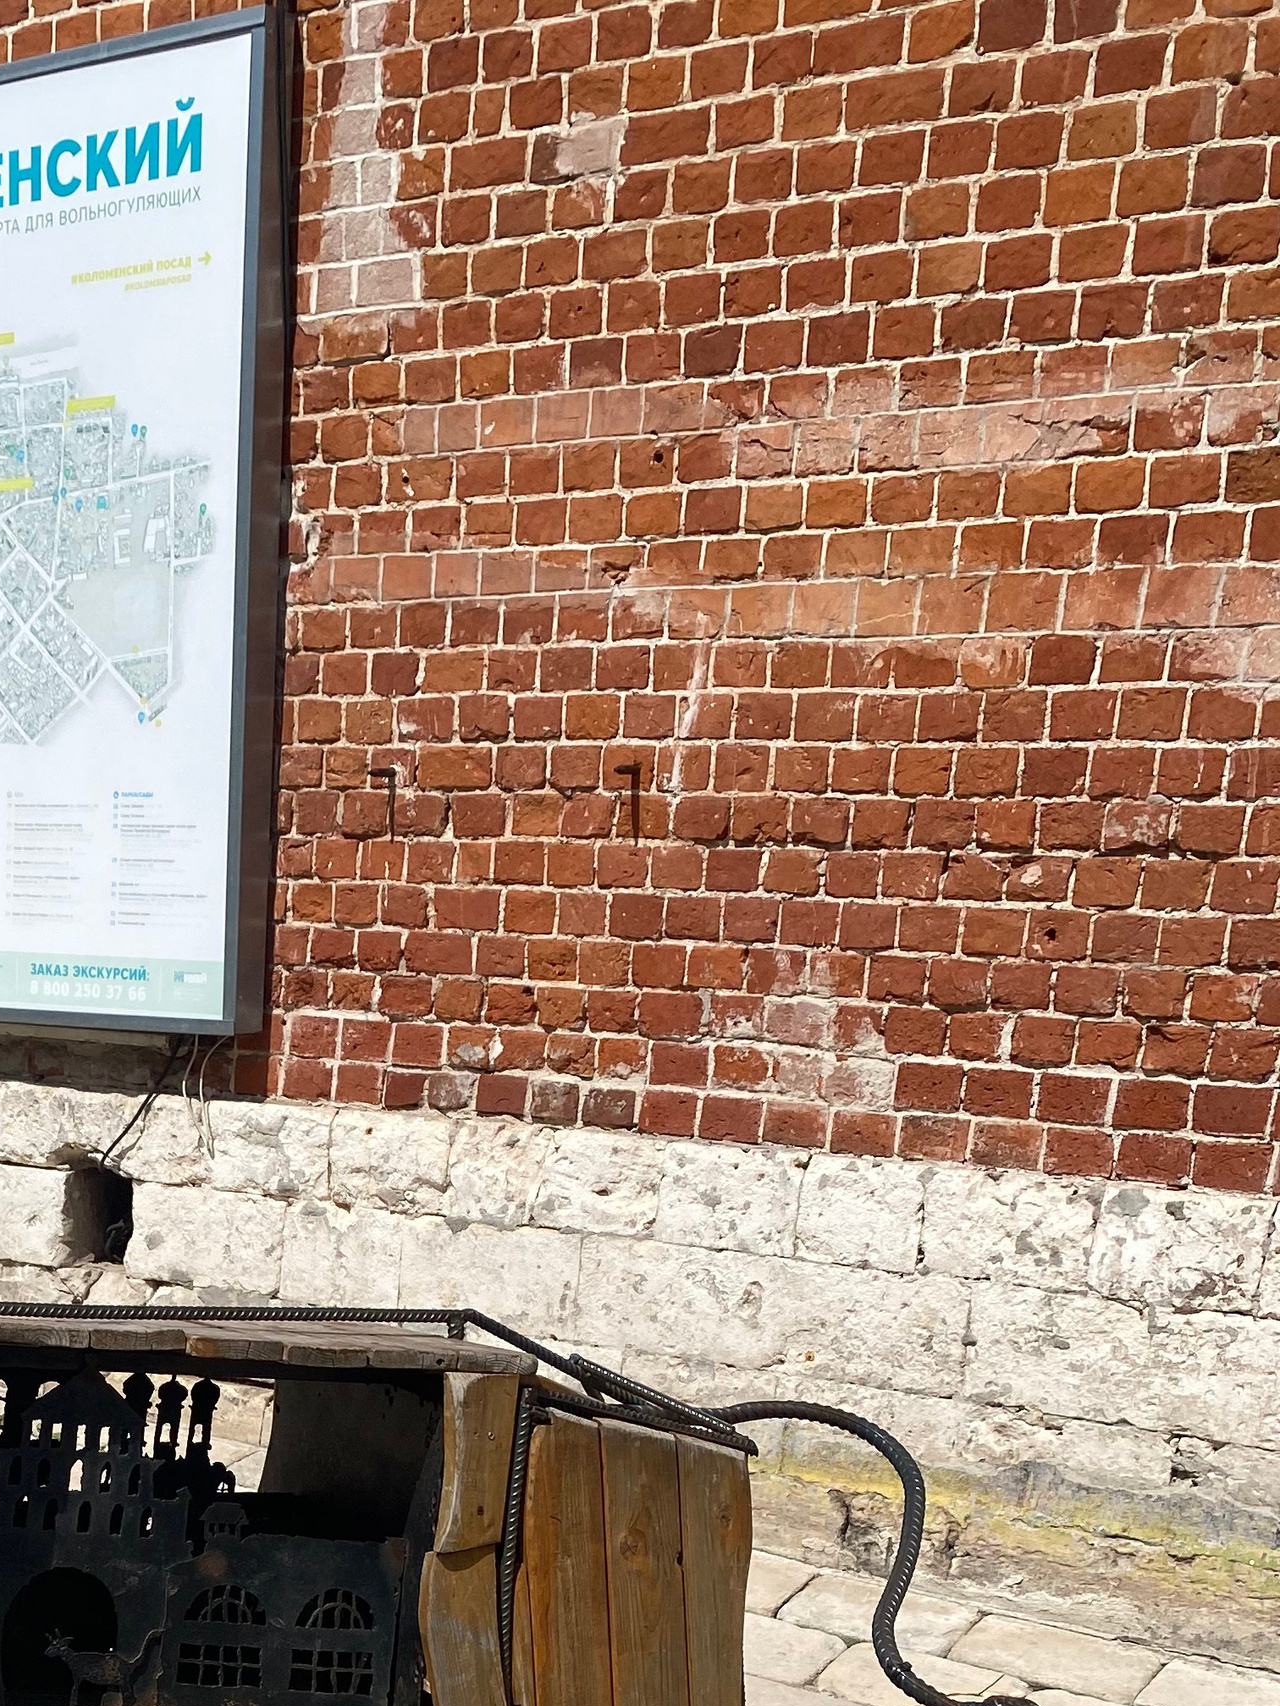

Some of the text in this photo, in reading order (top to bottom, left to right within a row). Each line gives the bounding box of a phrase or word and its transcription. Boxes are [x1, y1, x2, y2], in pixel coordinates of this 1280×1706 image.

[25, 212, 54, 234] ДЛЯ
[59, 185, 202, 225] ВОЛЬНОГУЛЯЮЩИХ
[156, 256, 192, 272] ПОСАД
[30, 962, 150, 982] ЗАКАЗ ЭКСКУРСИЙ:
[30, 980, 147, 1001] 8 800 250 37 66
